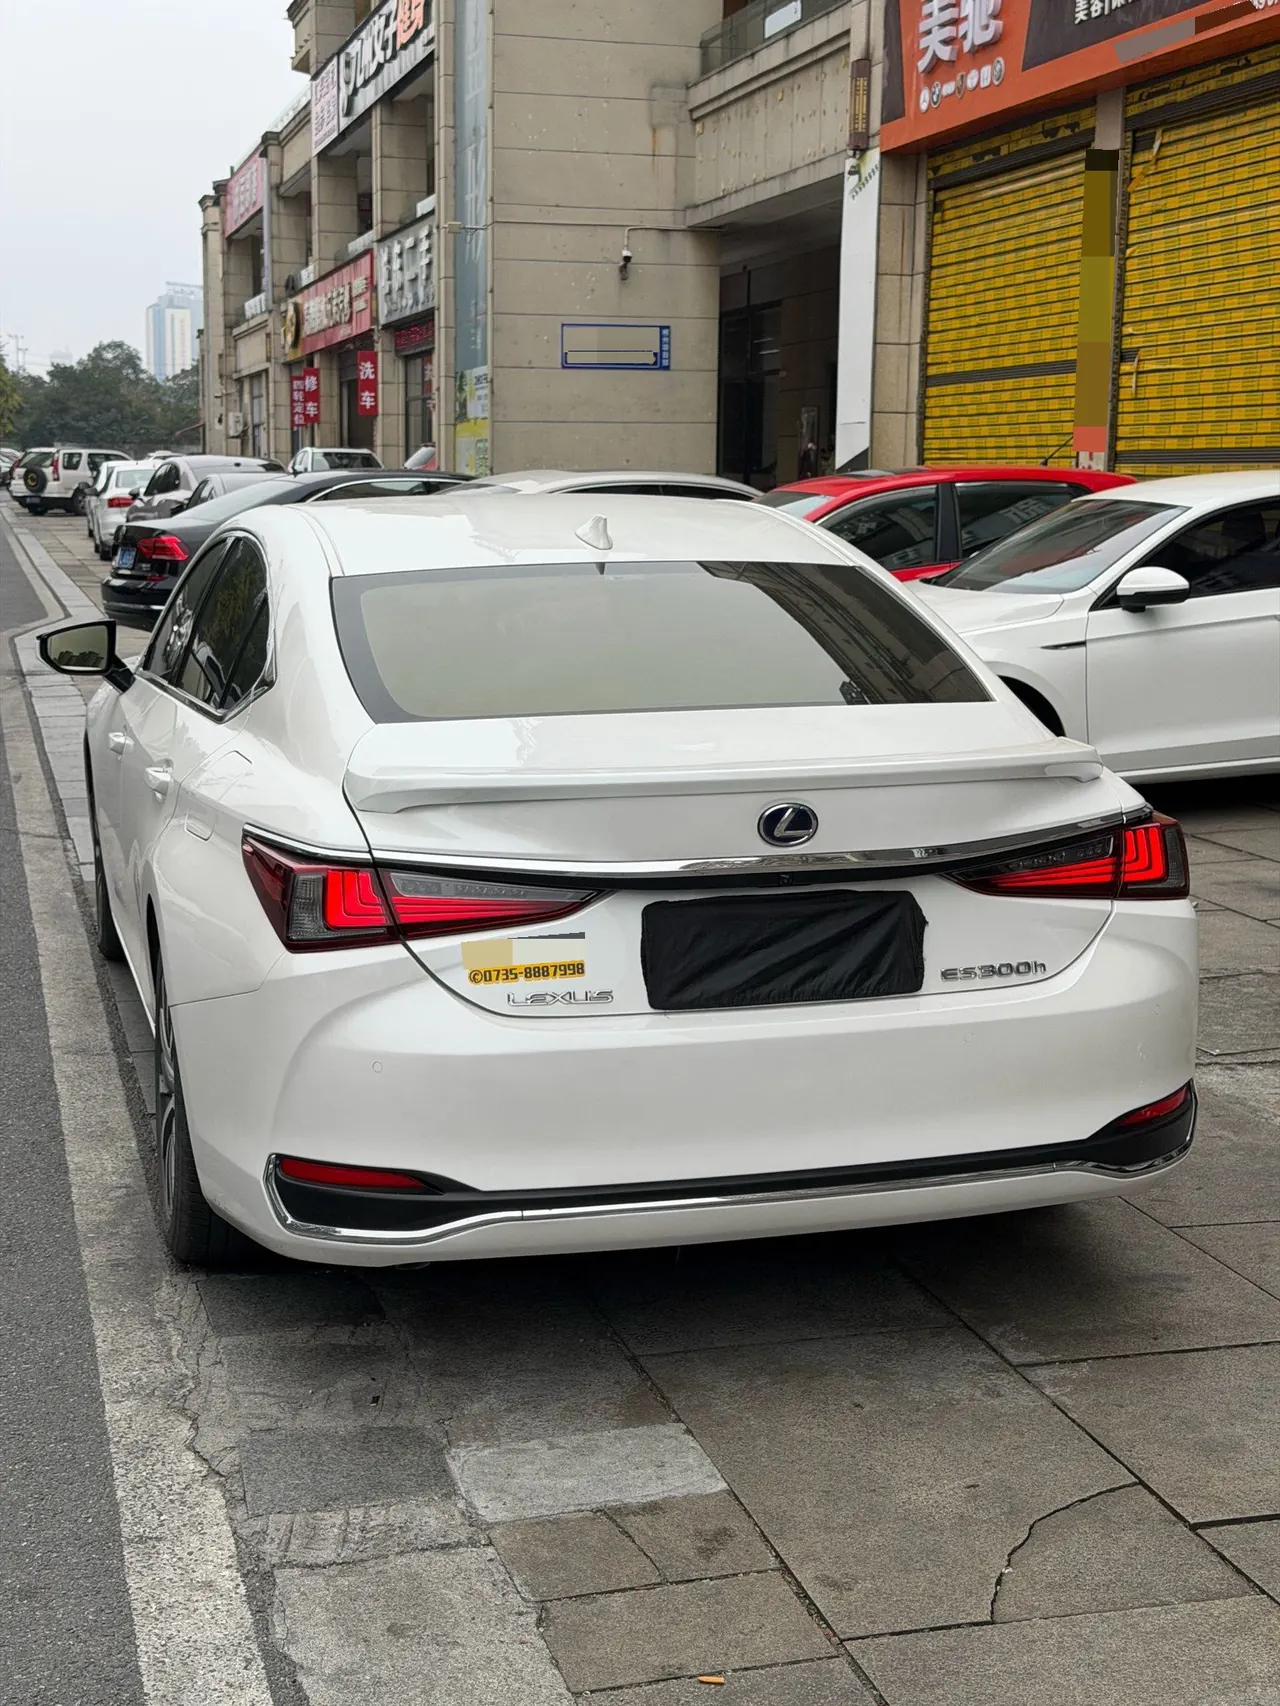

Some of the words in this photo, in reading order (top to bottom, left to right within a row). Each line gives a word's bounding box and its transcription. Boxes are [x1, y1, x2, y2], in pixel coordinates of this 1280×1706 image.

[304, 375, 318, 417] 修车
[359, 361, 375, 409] 洗车
[941, 961, 1046, 982] ES300h
[507, 989, 614, 1007] LEXUS
